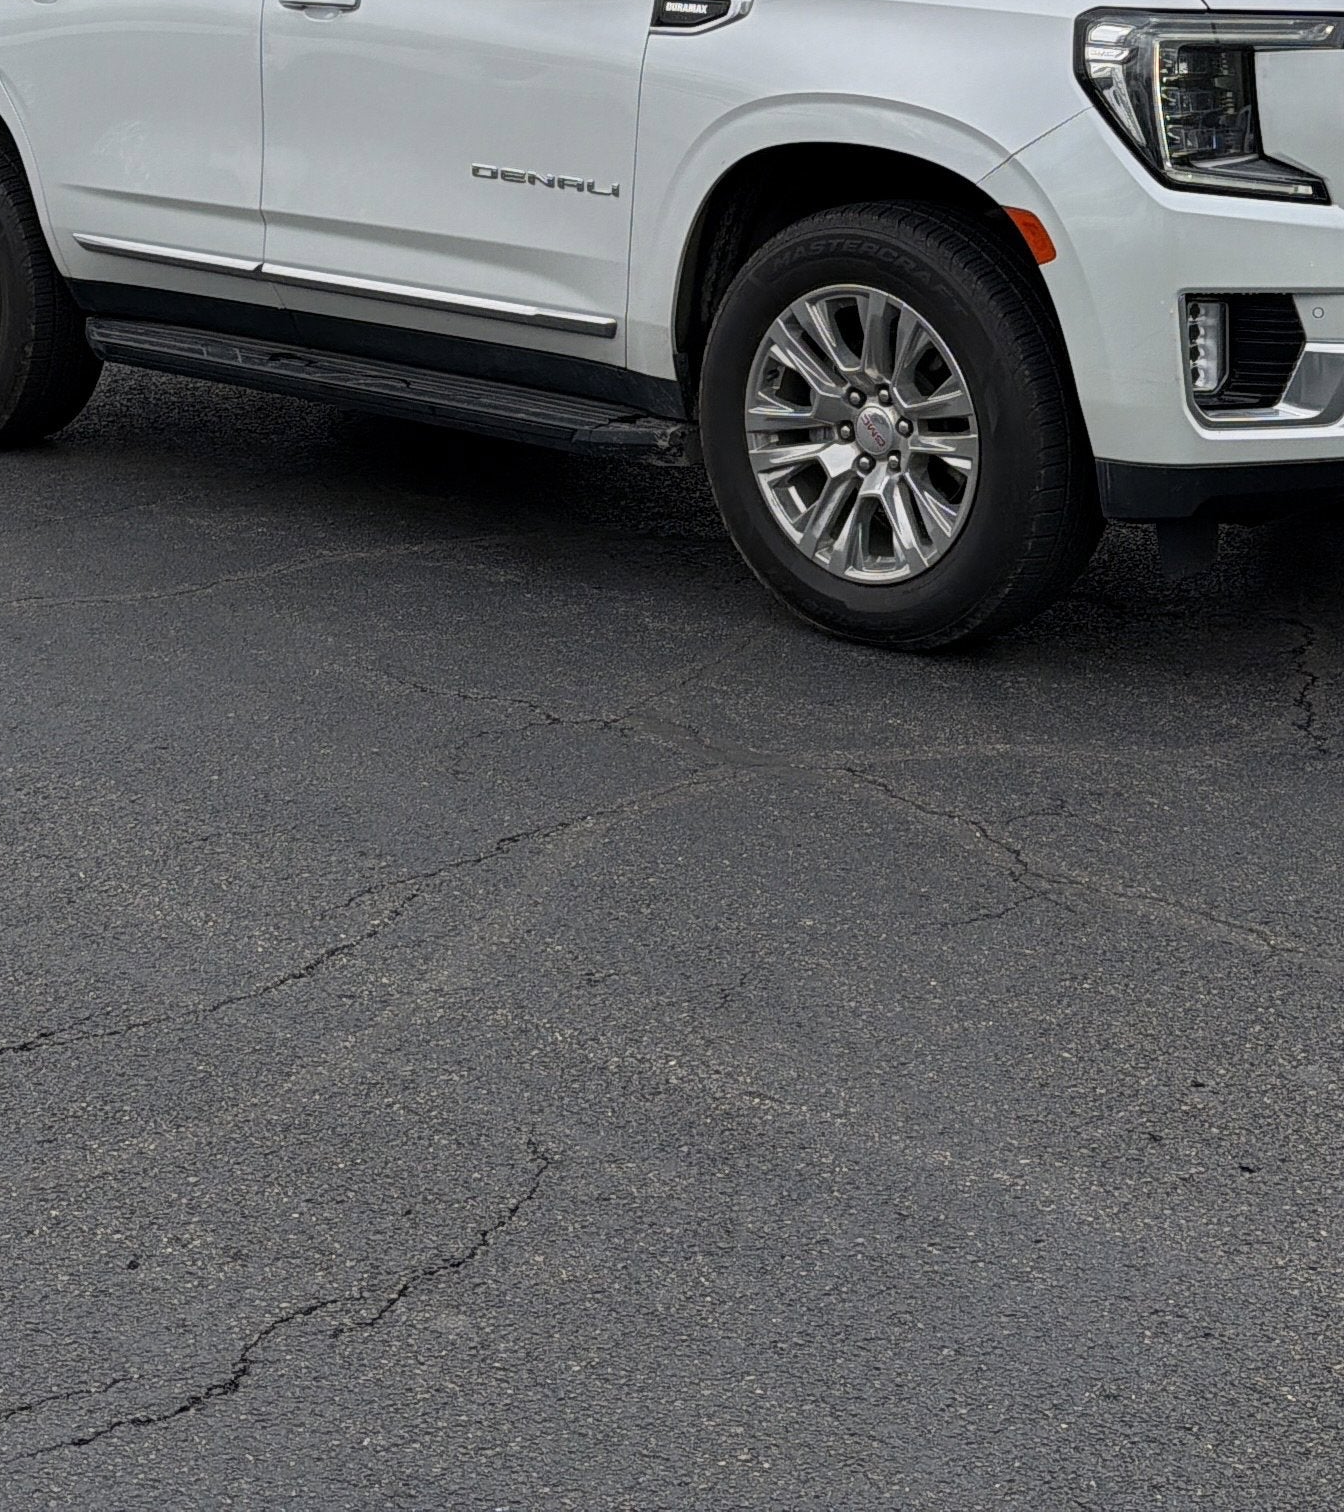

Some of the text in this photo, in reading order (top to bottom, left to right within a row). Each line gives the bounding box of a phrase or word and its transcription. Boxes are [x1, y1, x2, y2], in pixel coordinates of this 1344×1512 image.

[665, 1, 708, 14] DURAMAX
[471, 163, 621, 198] DENALI
[773, 238, 954, 300] MASTERCRA
[860, 414, 886, 447] GMC
